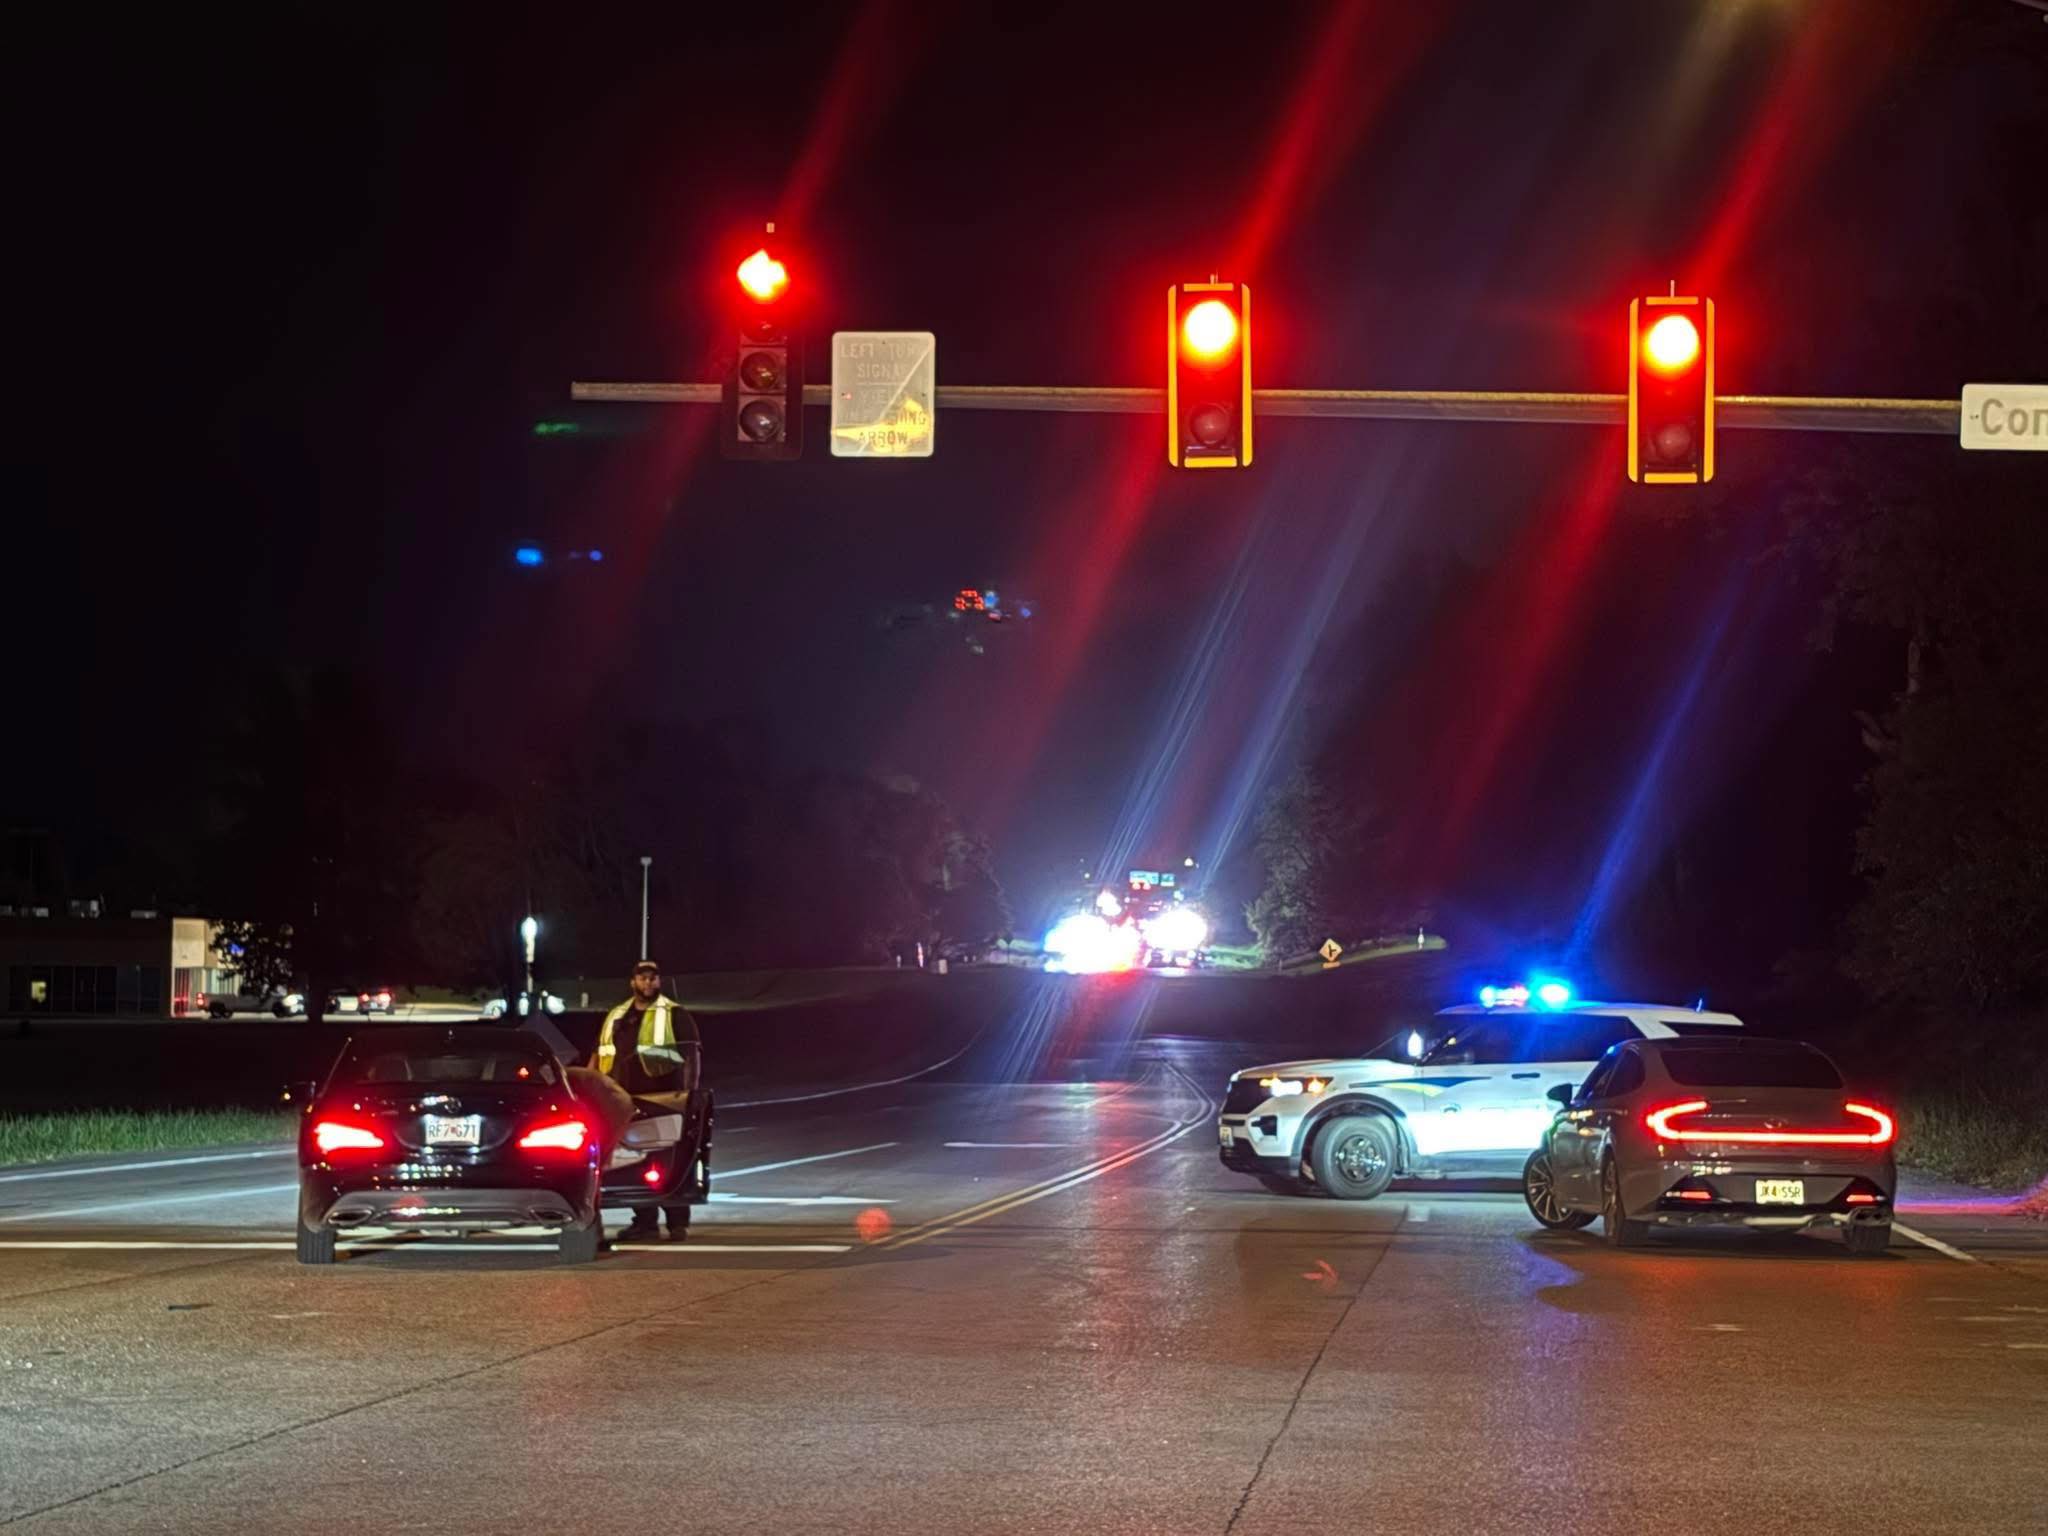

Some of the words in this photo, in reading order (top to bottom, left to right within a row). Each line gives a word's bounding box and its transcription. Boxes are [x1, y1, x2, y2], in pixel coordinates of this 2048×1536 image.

[840, 343, 874, 359] LEFT
[889, 343, 924, 360] TUR
[857, 362, 909, 379] SIGNA
[858, 431, 909, 447] ARROW
